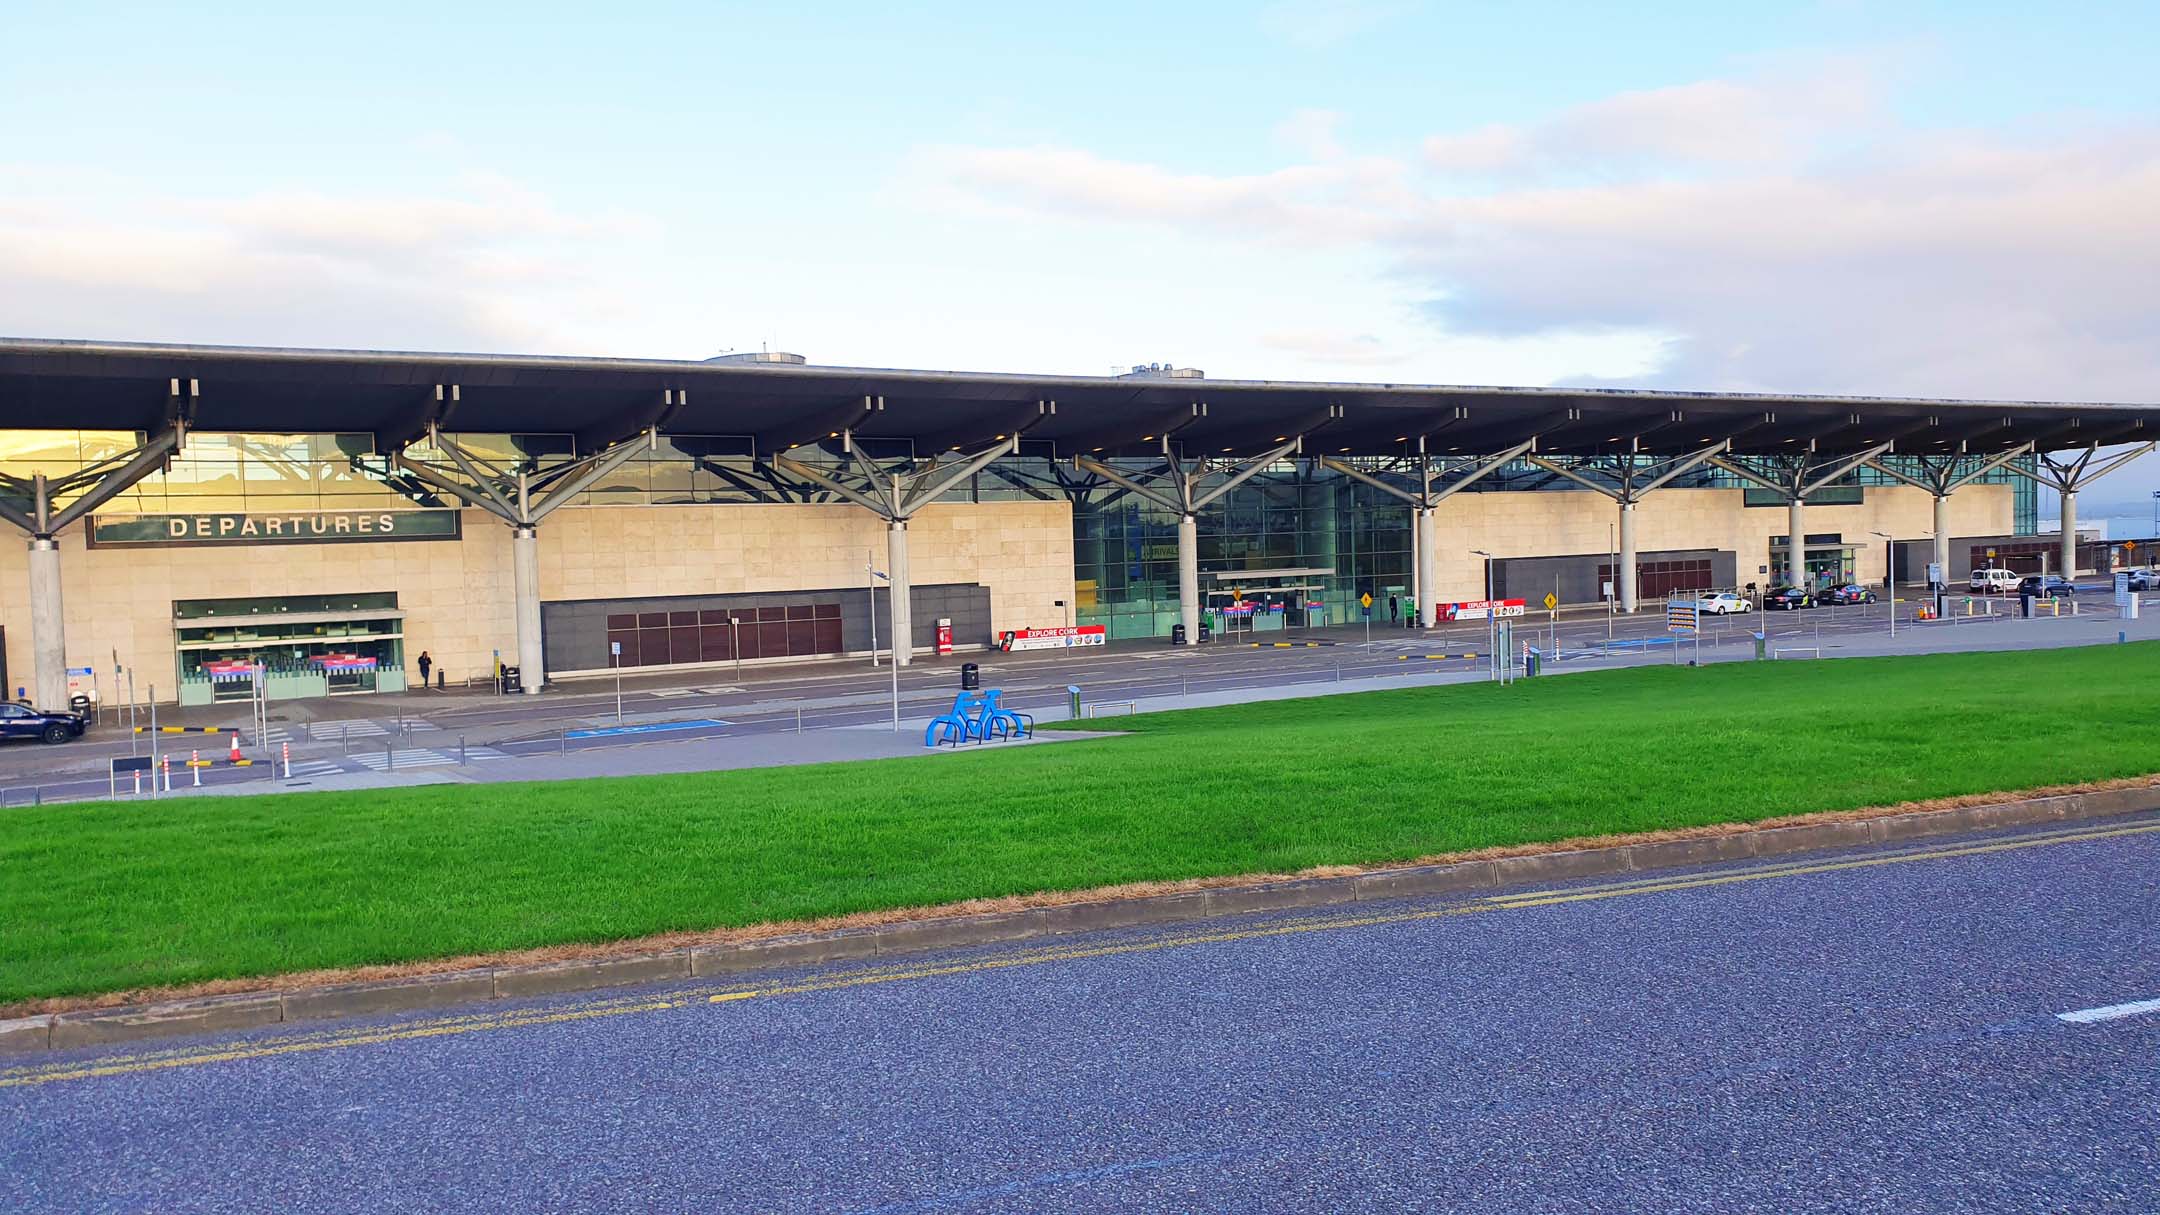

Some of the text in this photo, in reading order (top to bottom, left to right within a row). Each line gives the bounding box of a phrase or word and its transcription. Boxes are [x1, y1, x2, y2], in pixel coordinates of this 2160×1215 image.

[170, 514, 394, 537] DEPARTURES
[1027, 627, 1079, 638] EXPLORE CORK
